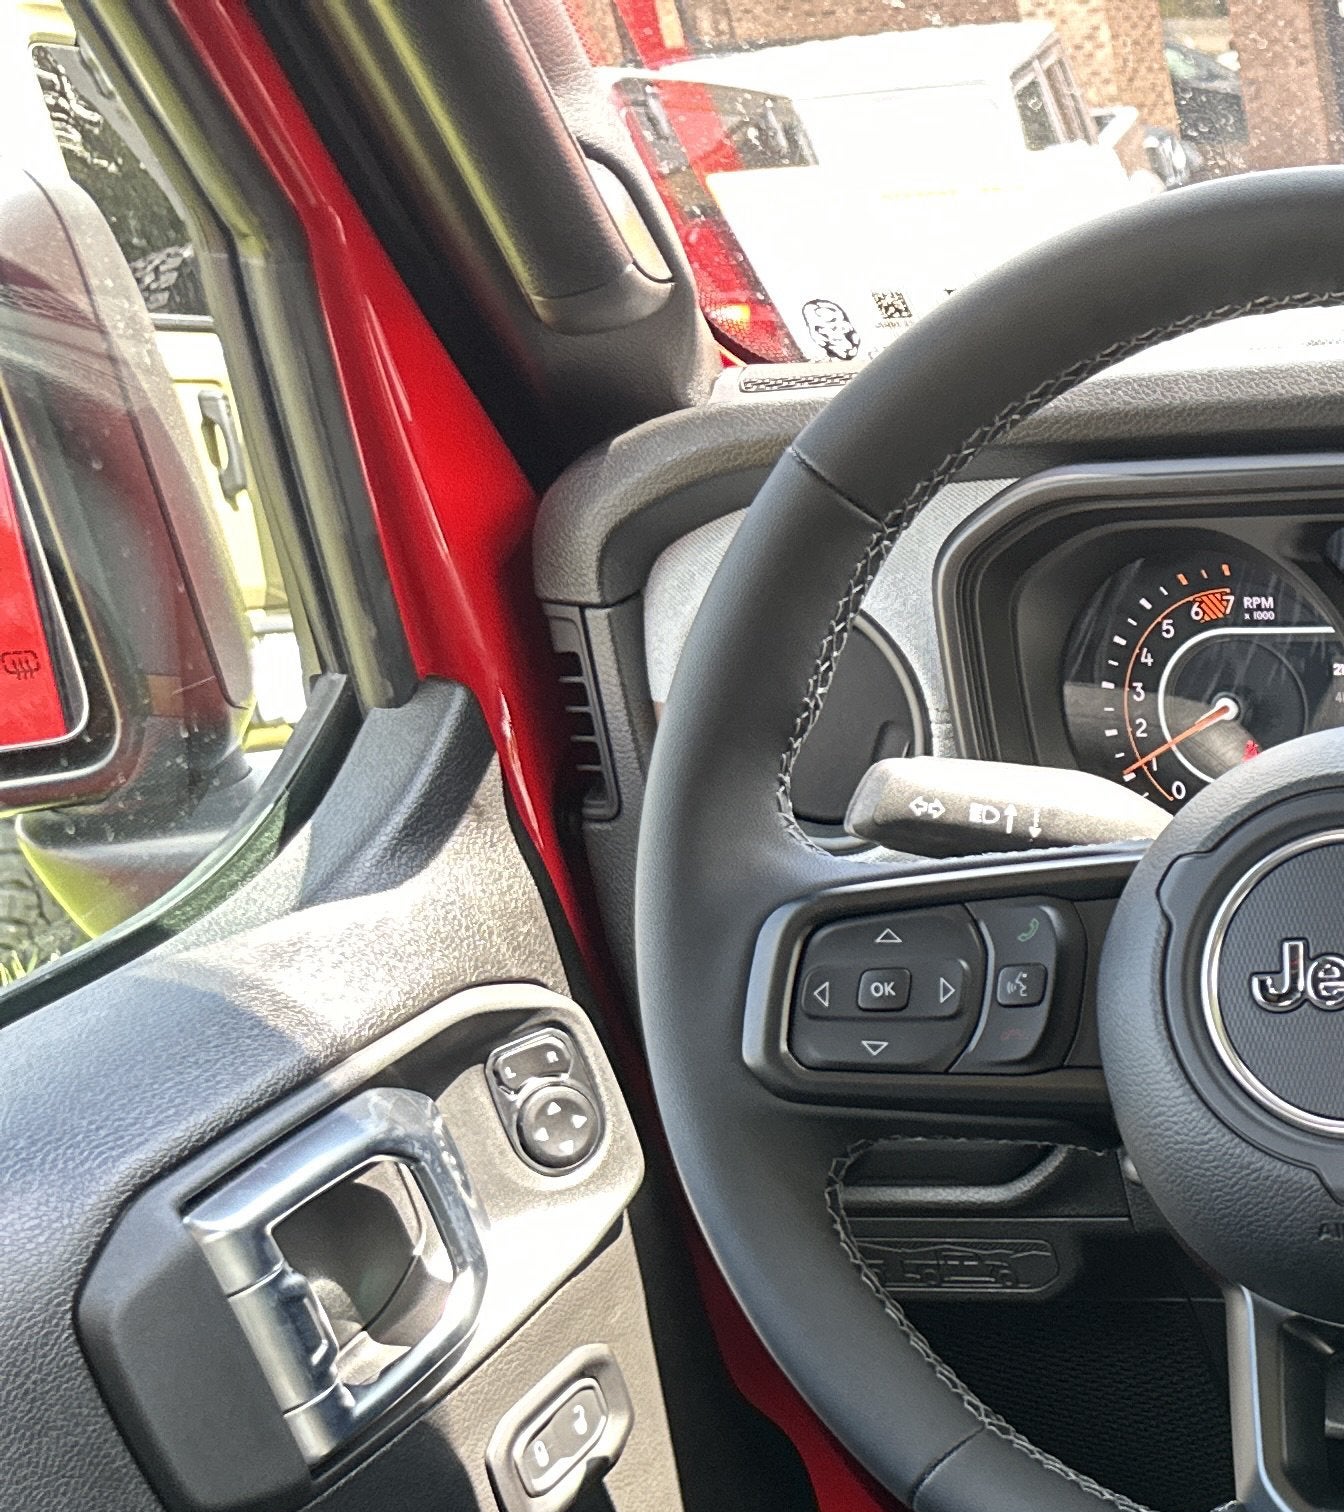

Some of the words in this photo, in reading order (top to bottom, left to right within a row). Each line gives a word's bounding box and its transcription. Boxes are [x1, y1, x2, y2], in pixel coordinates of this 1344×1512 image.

[1222, 595, 1235, 615] 7
[1243, 597, 1274, 610] RPM
[1191, 605, 1203, 621] 6
[1253, 611, 1275, 620] 1000
[1161, 620, 1175, 639] 5
[1140, 648, 1154, 666] 4
[1133, 682, 1145, 702] 3
[1135, 718, 1148, 738] 2
[1171, 781, 1186, 800] 0
[870, 981, 896, 998] OK
